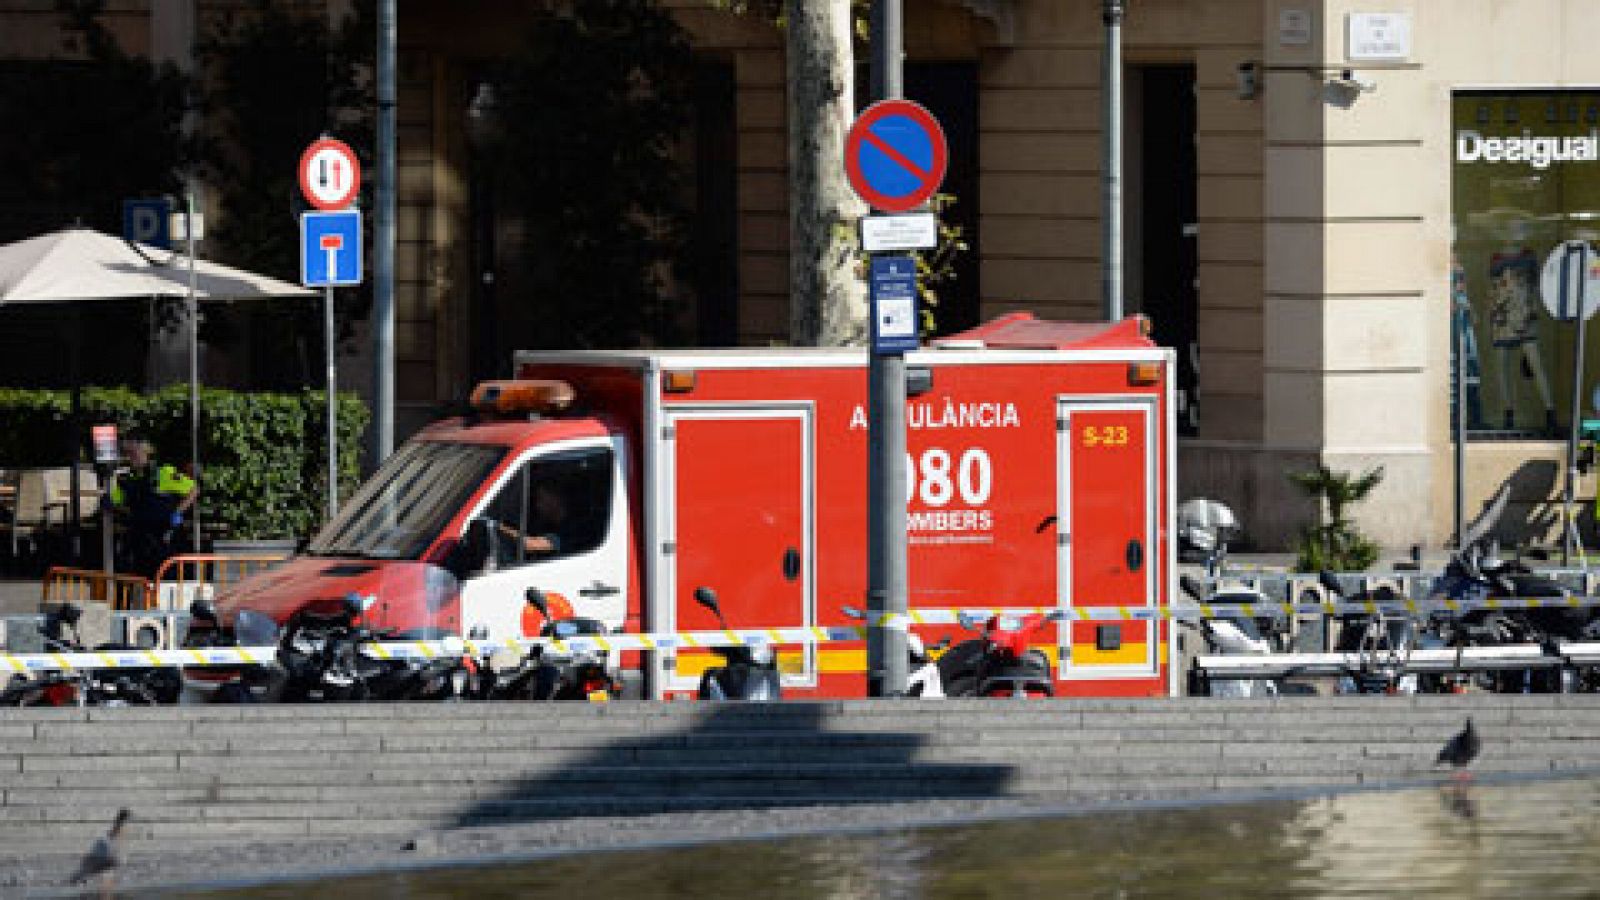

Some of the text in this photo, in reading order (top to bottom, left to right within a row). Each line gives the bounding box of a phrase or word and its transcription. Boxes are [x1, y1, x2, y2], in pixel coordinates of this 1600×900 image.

[849, 396, 1020, 430] AULÀNCIA
[1082, 426, 1129, 447] S-23
[907, 448, 993, 507] 80
